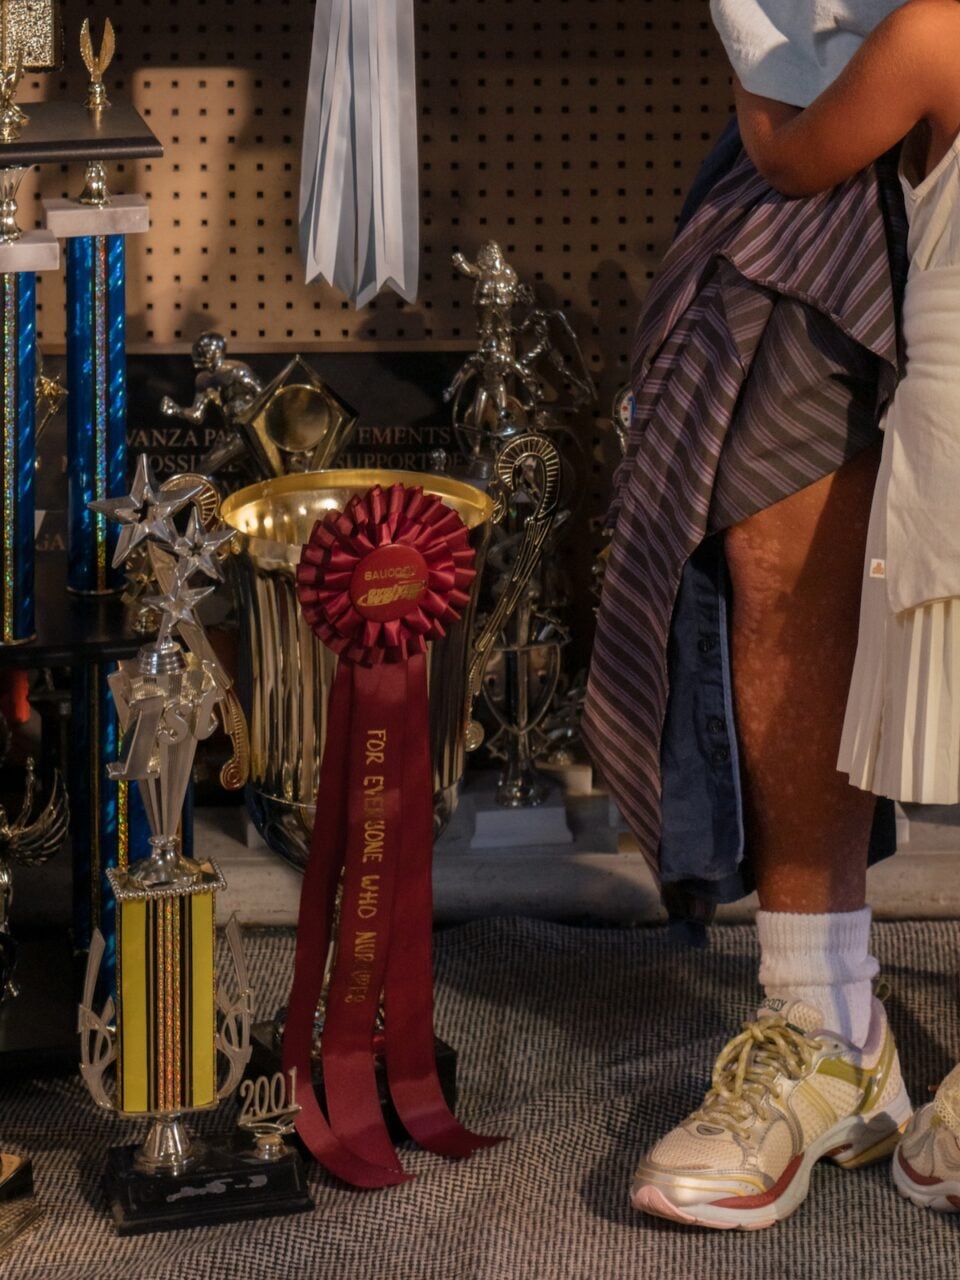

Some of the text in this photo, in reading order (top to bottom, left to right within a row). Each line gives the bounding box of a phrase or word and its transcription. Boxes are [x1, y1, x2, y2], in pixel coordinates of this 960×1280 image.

[365, 728, 387, 766] FOR
[357, 874, 381, 920] WHO
[239, 1066, 299, 1121] 2001
